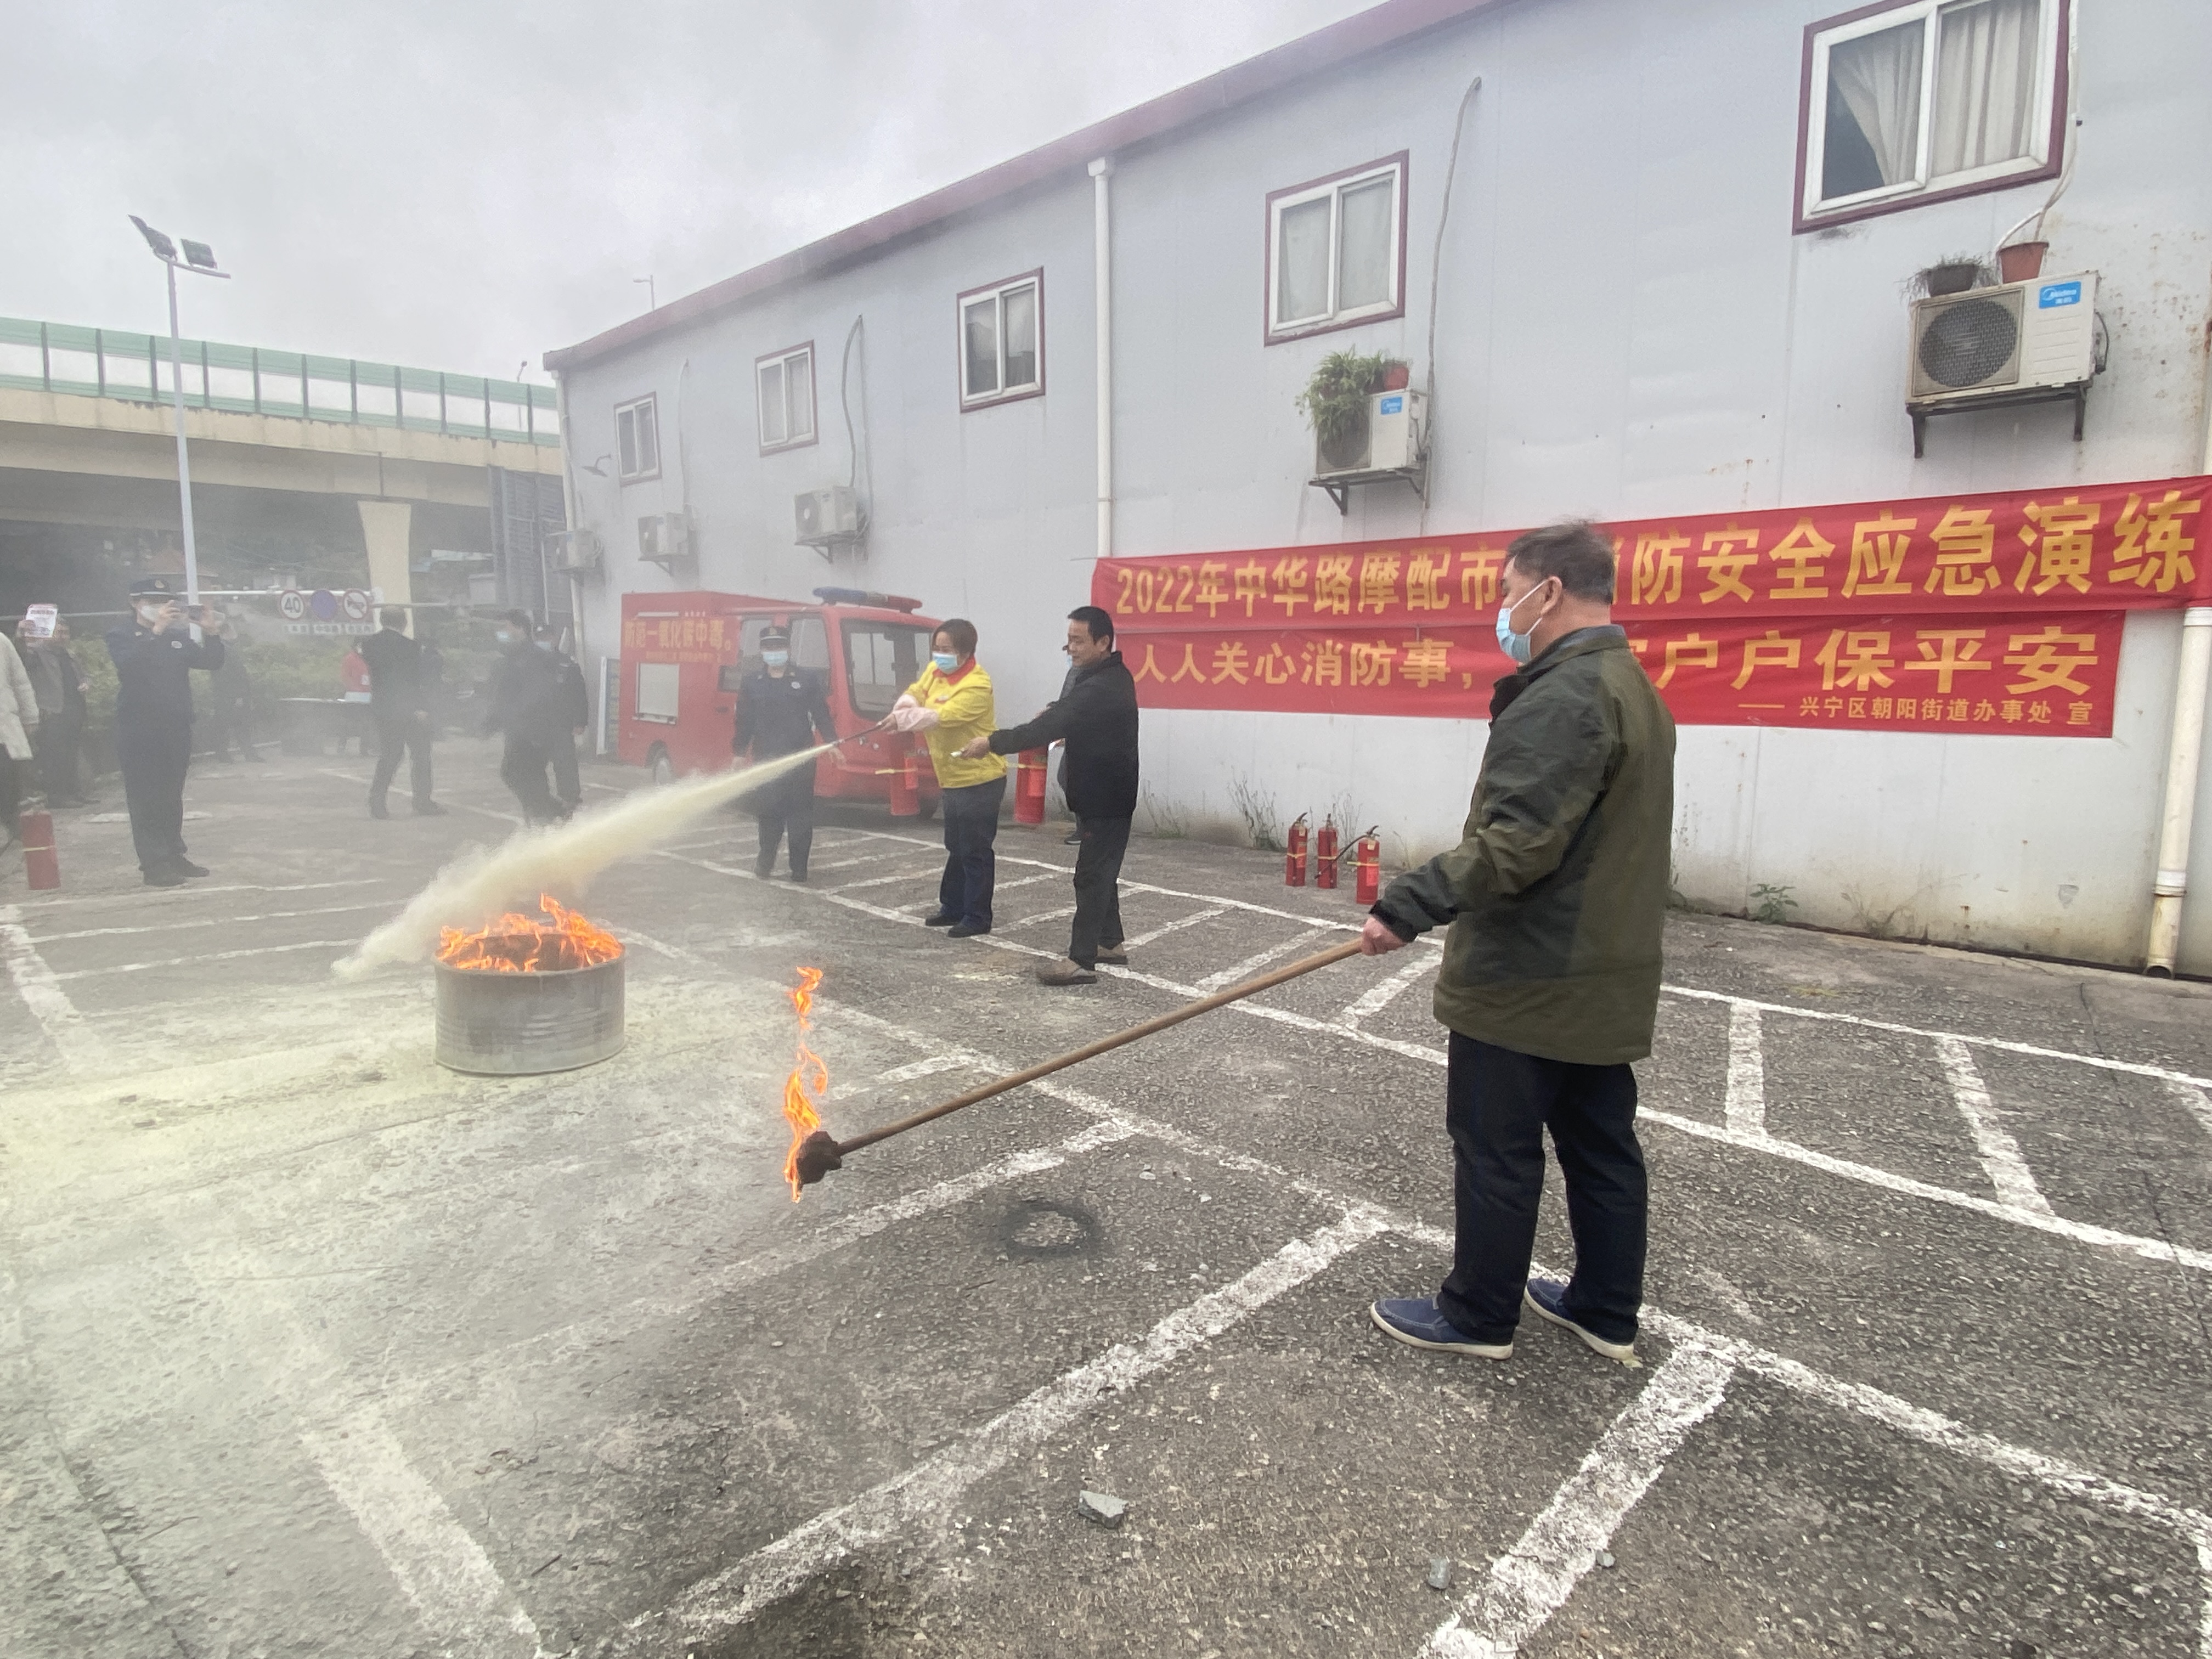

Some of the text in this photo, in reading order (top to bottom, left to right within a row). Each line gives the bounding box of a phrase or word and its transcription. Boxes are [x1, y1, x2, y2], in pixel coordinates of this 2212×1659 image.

[1116, 490, 2201, 618] 2022年中华路摩配市防安全应急演练
[284, 596, 301, 613] 40
[1133, 626, 2098, 695] 人人关心消防事，户户保平安
